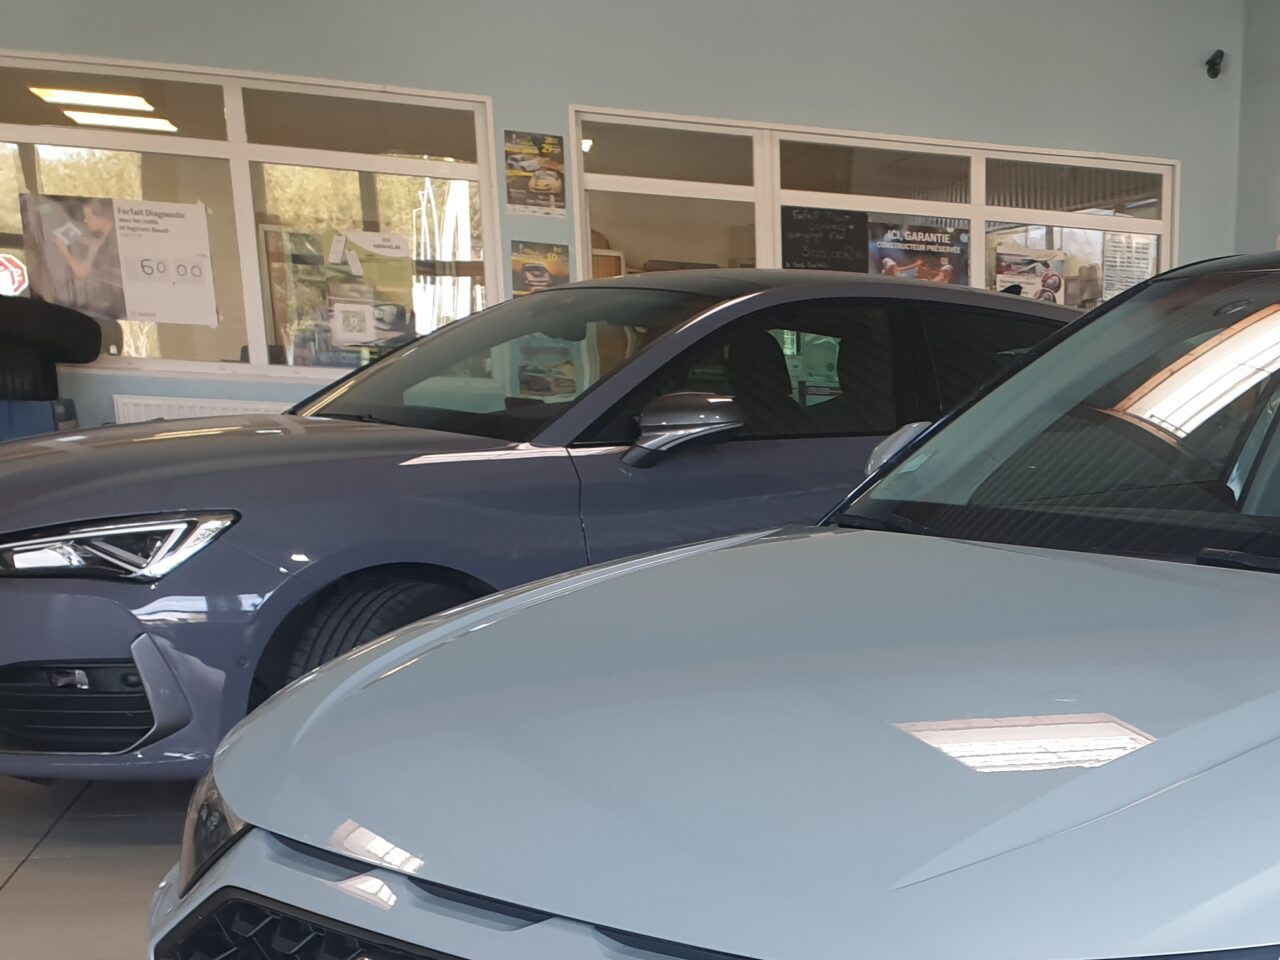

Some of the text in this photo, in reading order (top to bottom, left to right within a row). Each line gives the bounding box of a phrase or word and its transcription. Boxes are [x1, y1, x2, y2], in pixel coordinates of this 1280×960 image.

[887, 229, 951, 243] ICI, GARANTIE
[876, 241, 926, 251] CONSTRUCTEUR
